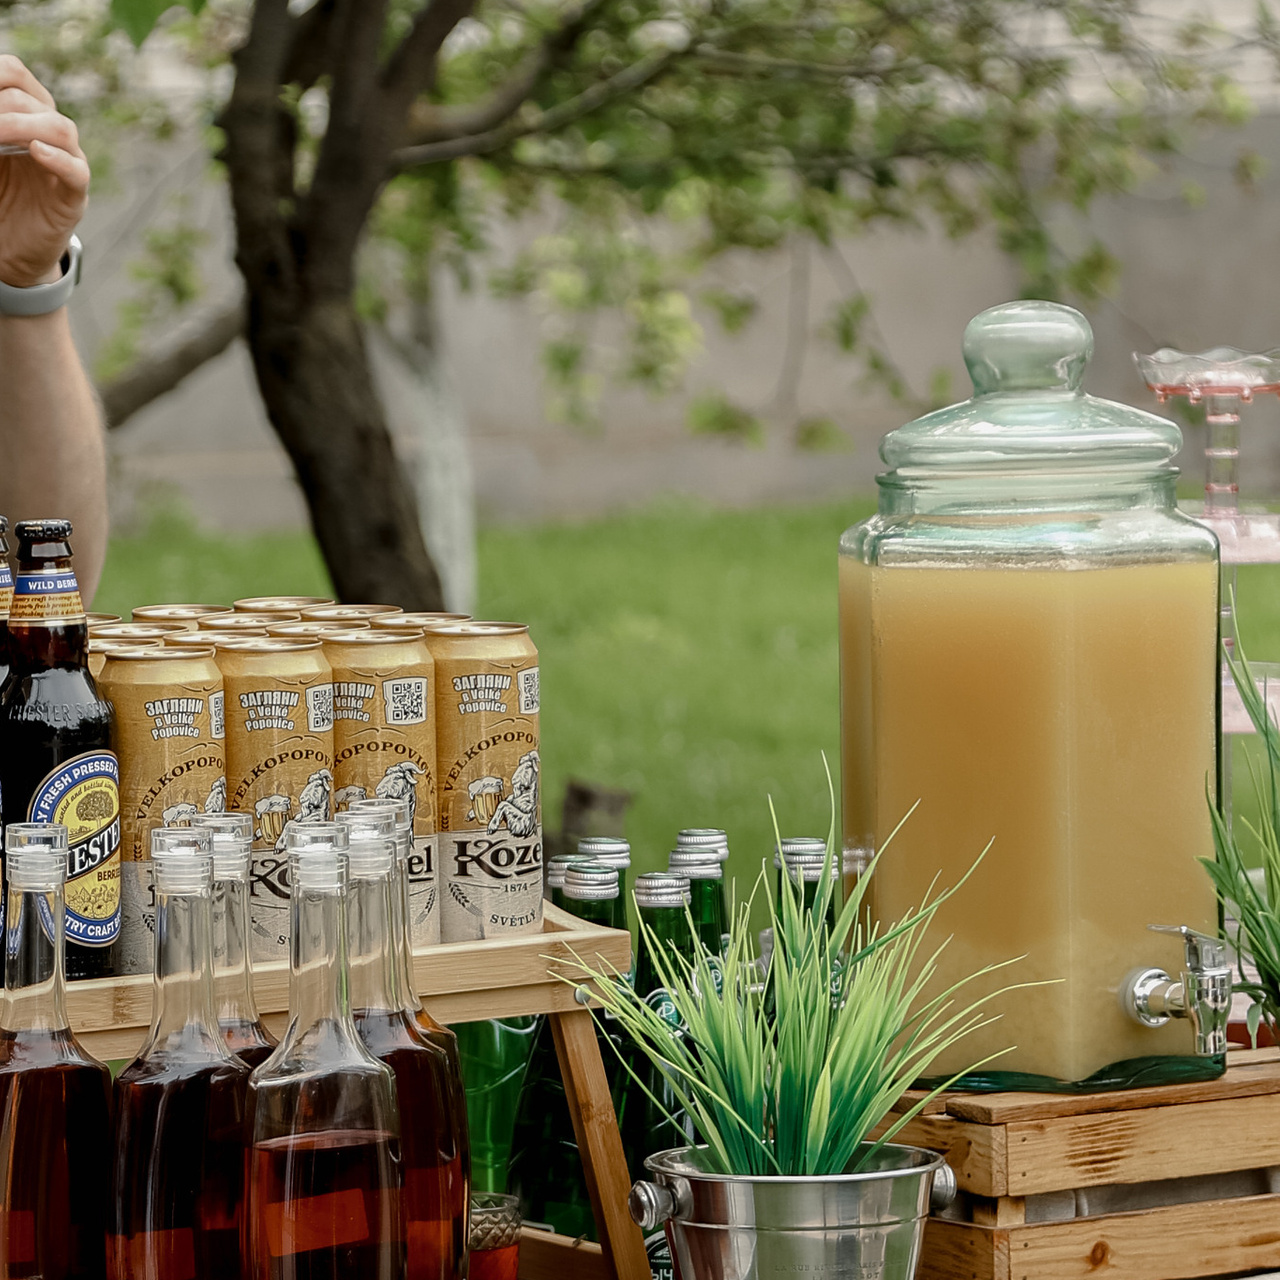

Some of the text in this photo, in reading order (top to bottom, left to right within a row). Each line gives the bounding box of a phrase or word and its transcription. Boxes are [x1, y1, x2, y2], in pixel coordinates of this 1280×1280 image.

[28, 581, 54, 590] WILD
[333, 682, 376, 699] ГЛЯНИ
[453, 674, 512, 692] ЗАГЛЯНИ
[145, 698, 204, 717] ЗАГЛЯНИ
[239, 690, 299, 709] ЗАГЛЯНИ
[458, 700, 508, 715] Popovice
[151, 724, 200, 741] Popovice
[245, 718, 295, 733] Popovice
[40, 760, 114, 811] FRESH PRESSED
[452, 839, 542, 879] Koze
[503, 882, 528, 893] 1874
[489, 908, 537, 927] SVĚTLÝ
[87, 921, 114, 937] CRAFT
